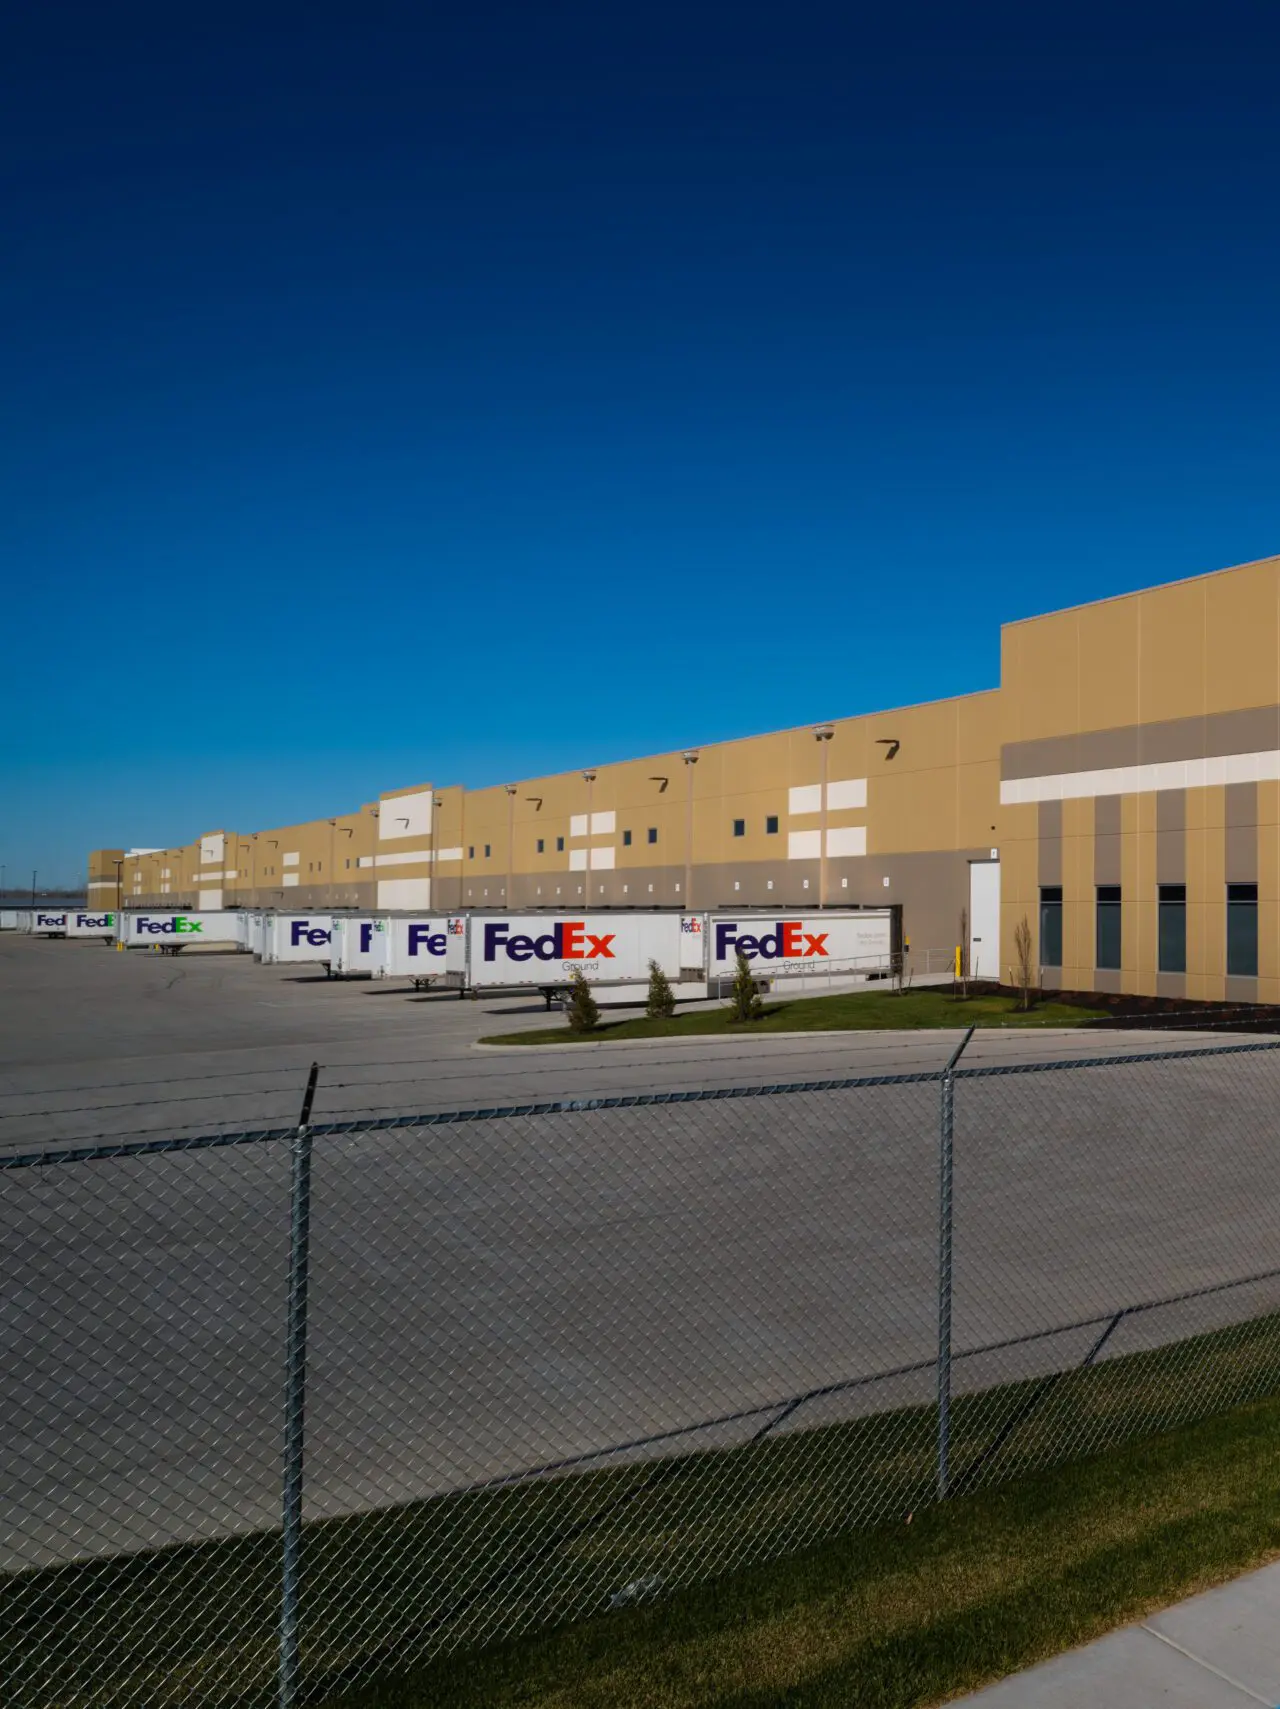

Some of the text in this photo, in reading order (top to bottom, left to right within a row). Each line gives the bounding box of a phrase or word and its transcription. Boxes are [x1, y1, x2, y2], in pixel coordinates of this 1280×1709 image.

[37, 914, 67, 927] Fed
[136, 916, 204, 934] FedEx
[484, 922, 617, 962] FedEx
[715, 921, 830, 961] FedEx
